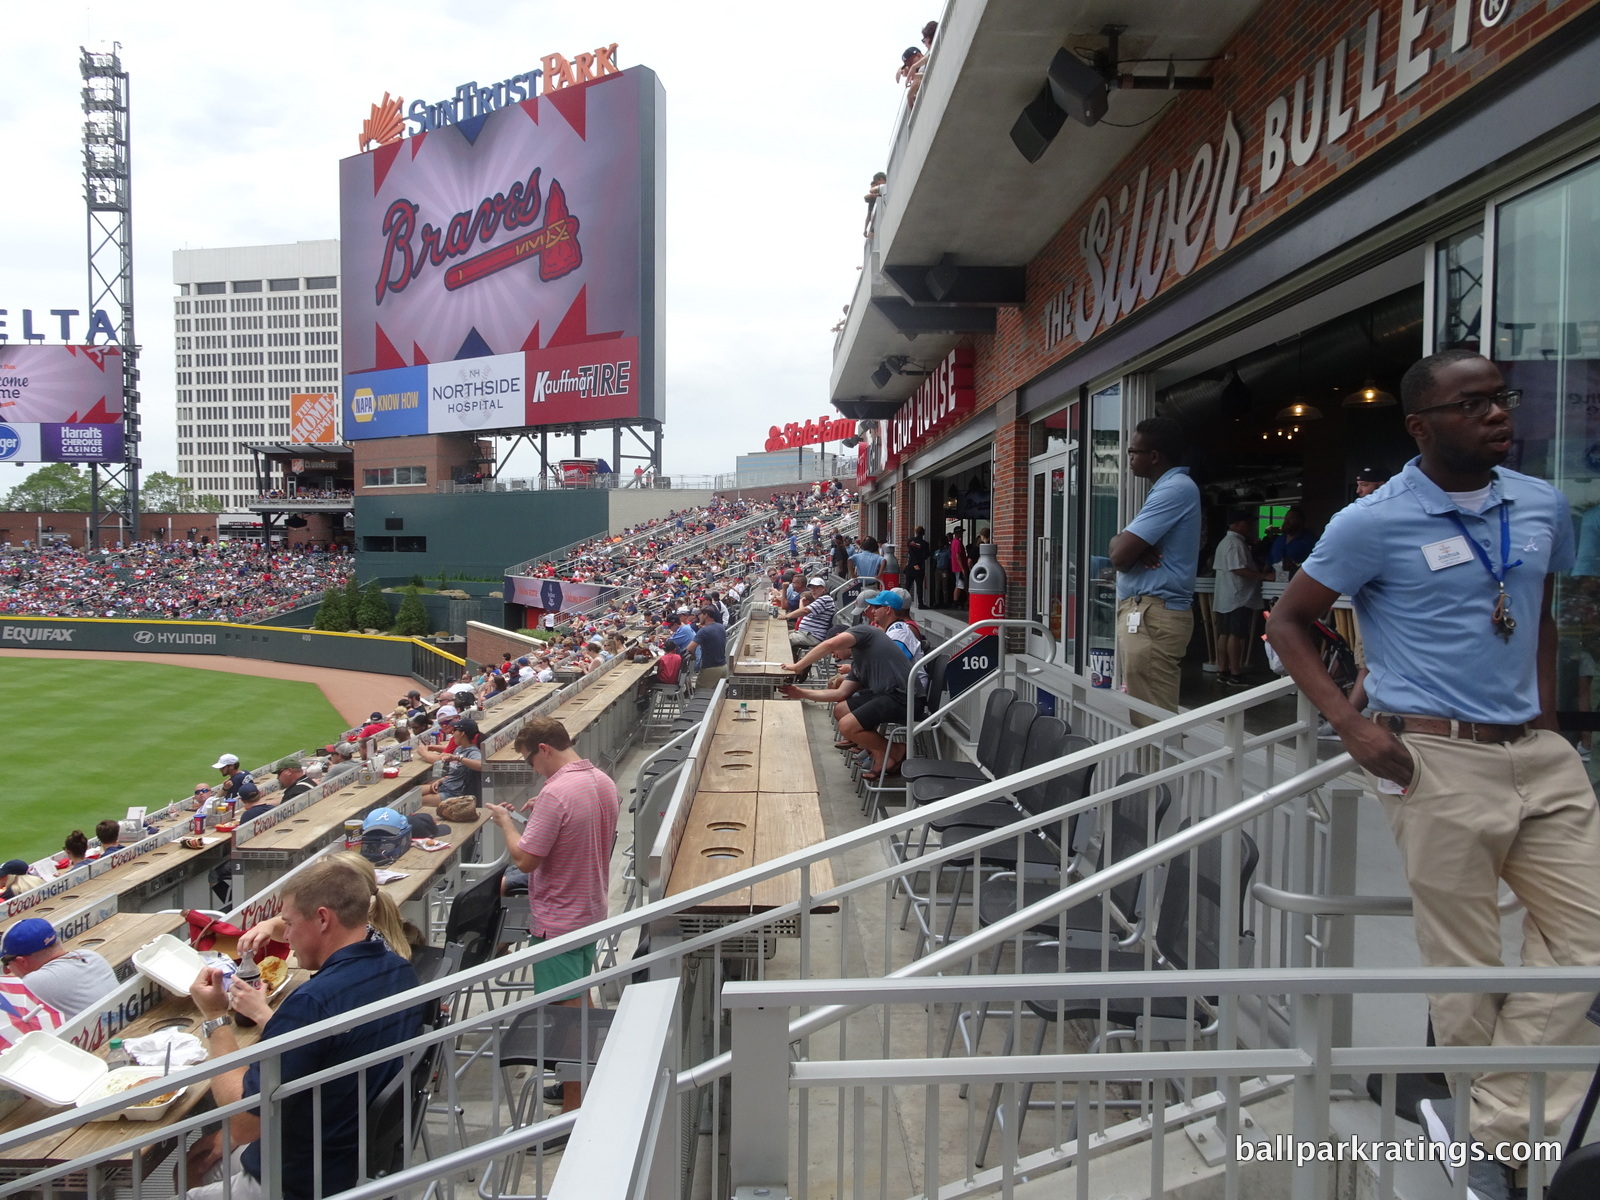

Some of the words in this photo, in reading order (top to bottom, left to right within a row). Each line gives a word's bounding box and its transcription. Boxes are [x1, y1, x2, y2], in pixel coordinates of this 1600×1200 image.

[375, 167, 542, 306] Braves
[1044, 281, 1075, 350] THE
[1074, 110, 1250, 343] Silver
[433, 377, 520, 401] NORTHSIDE
[532, 369, 594, 403] Kauffman
[578, 360, 631, 398] TIRE
[295, 398, 314, 418] THE
[355, 397, 373, 413] NAPA
[377, 393, 400, 412] KNOW
[401, 391, 419, 409] HOW
[448, 399, 504, 414] HOSPITAL
[892, 395, 914, 455] CHOP
[916, 348, 956, 438] HOUSE
[291, 393, 335, 442] HOME
[308, 411, 335, 443] DEPOT
[61, 427, 102, 438] Harrah's
[61, 438, 102, 446] CHEROKEE
[304, 460, 336, 469] CLUBHOUSE
[2, 626, 73, 644] EQUIFAX
[158, 632, 216, 645] HYUNDAI
[962, 656, 989, 670] 160
[732, 689, 738, 697] 5
[485, 776, 492, 784] 4
[276, 803, 296, 823] LIGHT
[110, 850, 138, 869] Coors
[137, 838, 159, 856] LIGHT
[235, 863, 241, 871] 3
[7, 896, 41, 918] Coors
[42, 878, 70, 901] LIGHT
